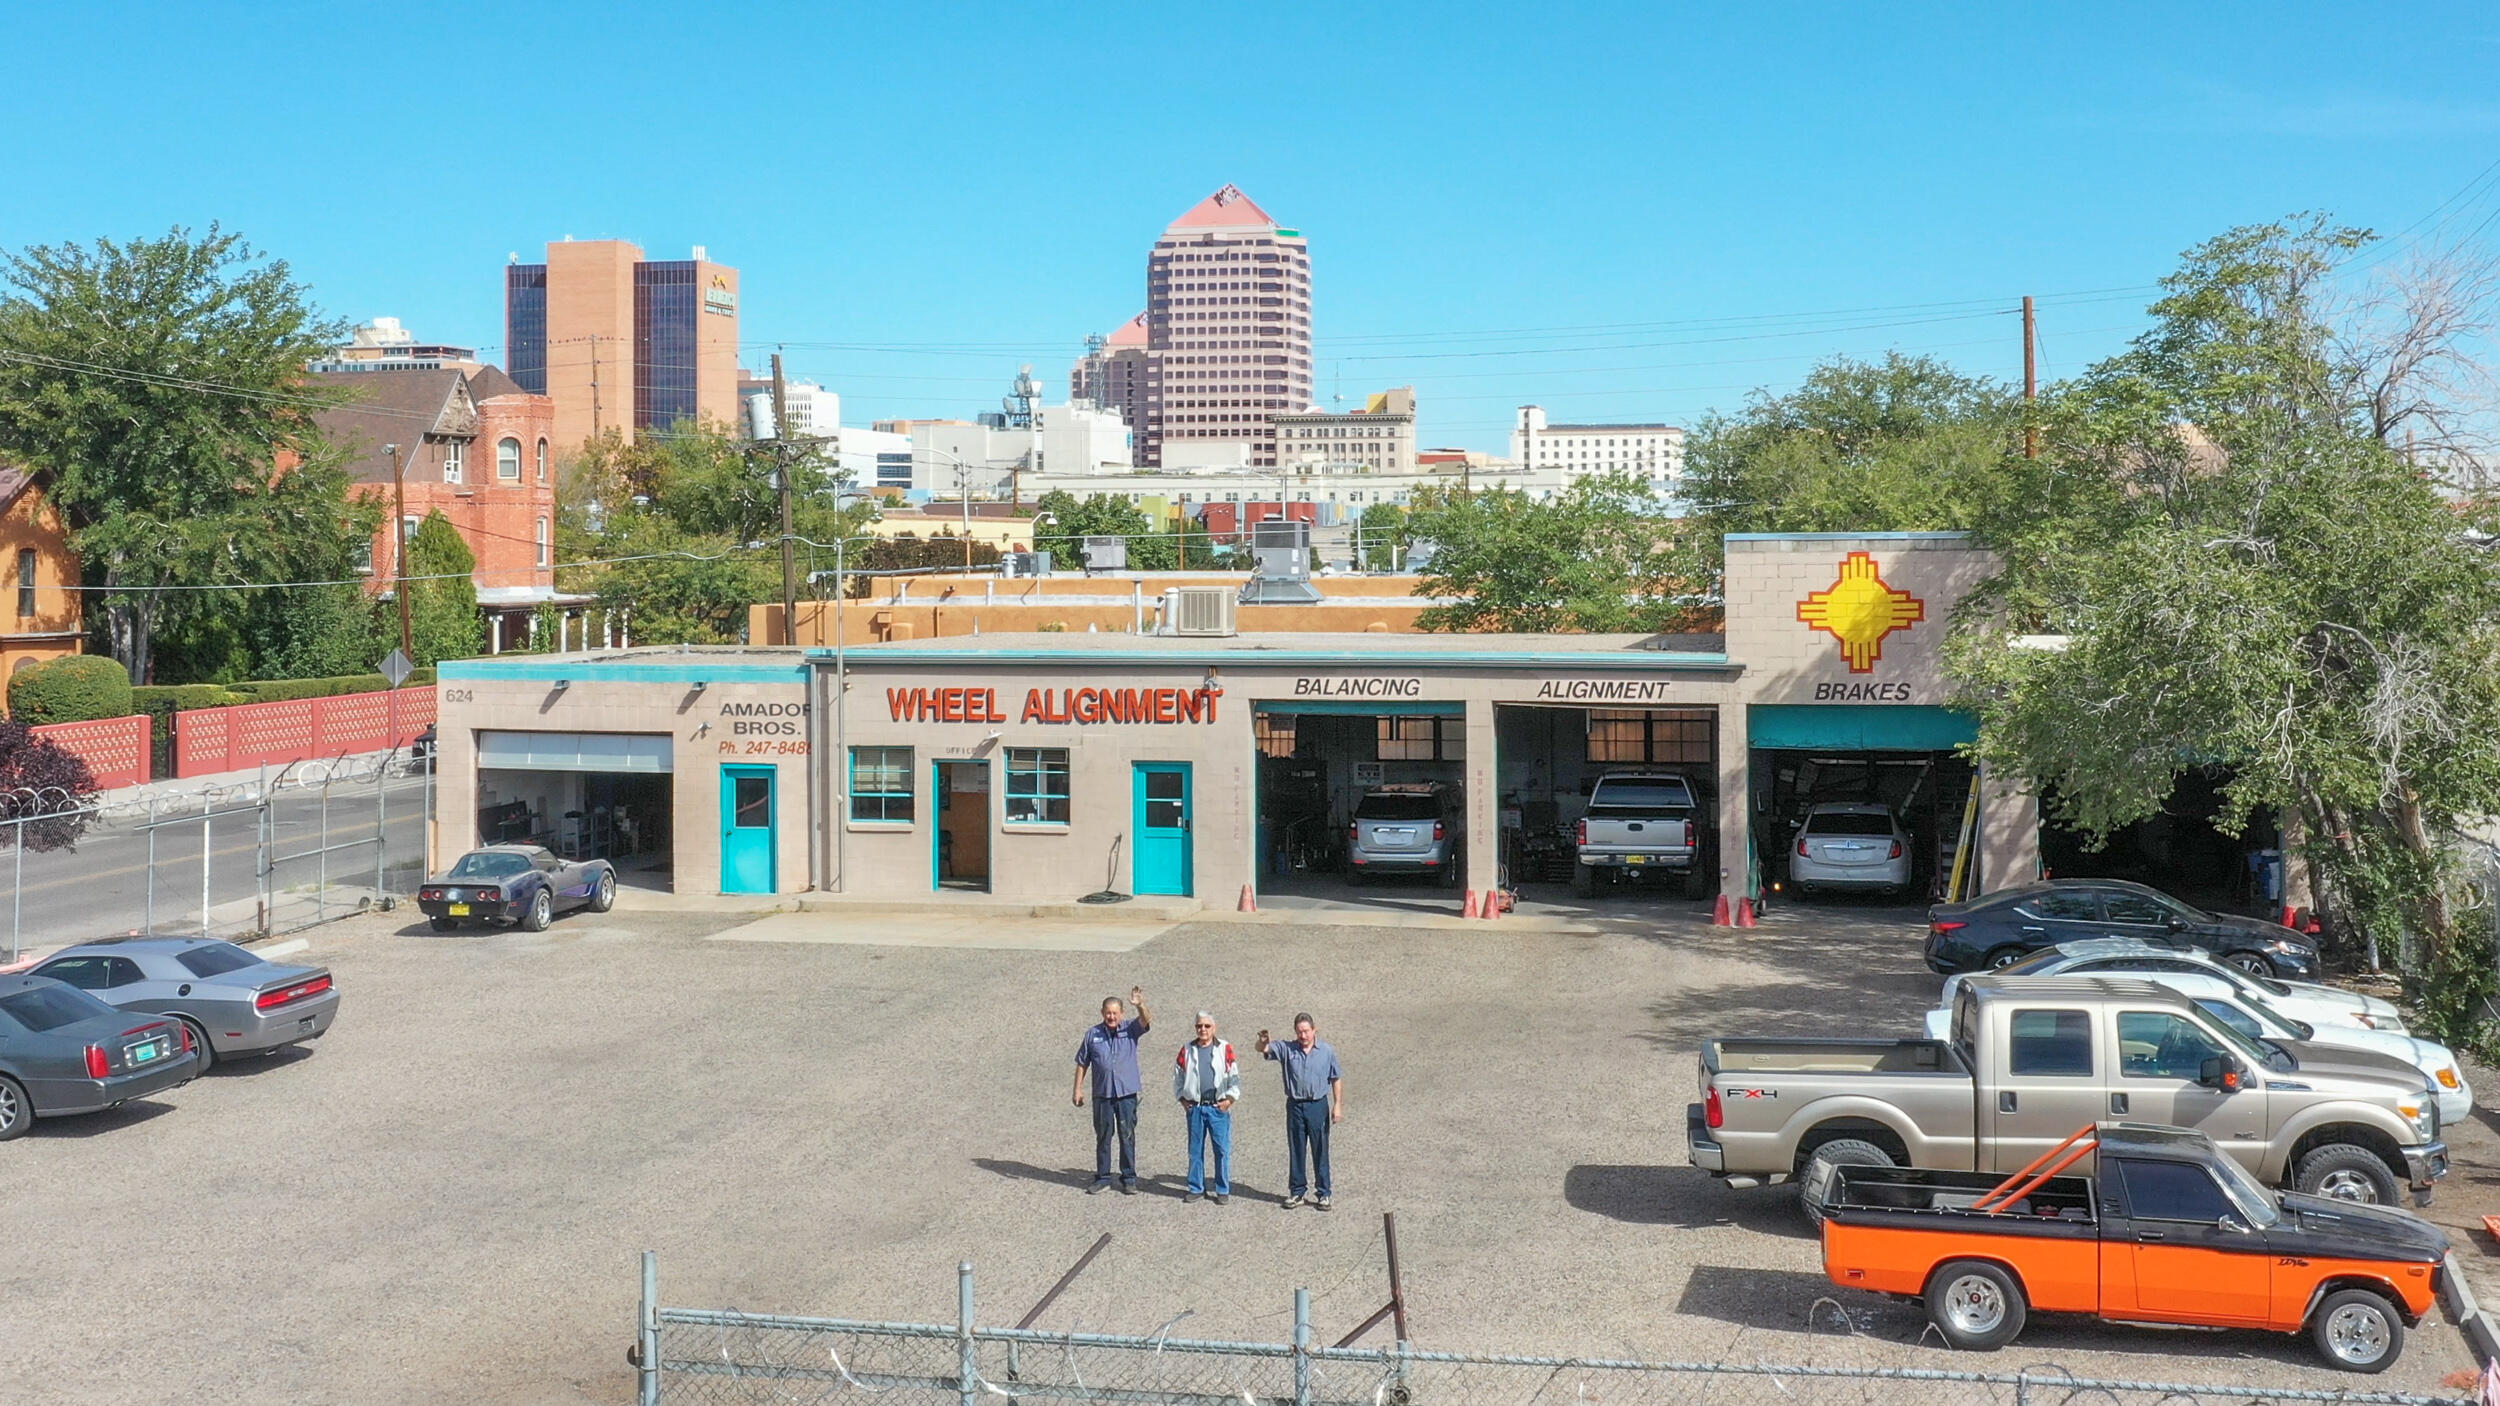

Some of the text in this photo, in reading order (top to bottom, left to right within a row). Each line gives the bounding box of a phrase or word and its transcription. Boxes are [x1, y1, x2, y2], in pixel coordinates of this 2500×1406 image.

[1294, 678, 1421, 696] BALANCING
[1537, 681, 1670, 699] ALIGNMENT
[1814, 682, 1912, 701] BRAKES
[446, 689, 473, 703] 624
[887, 687, 1224, 724] WHEEL ALIGNMENT
[734, 721, 801, 735] BROS.
[719, 741, 738, 755] Ph.
[1727, 1088, 1777, 1099] FX4
